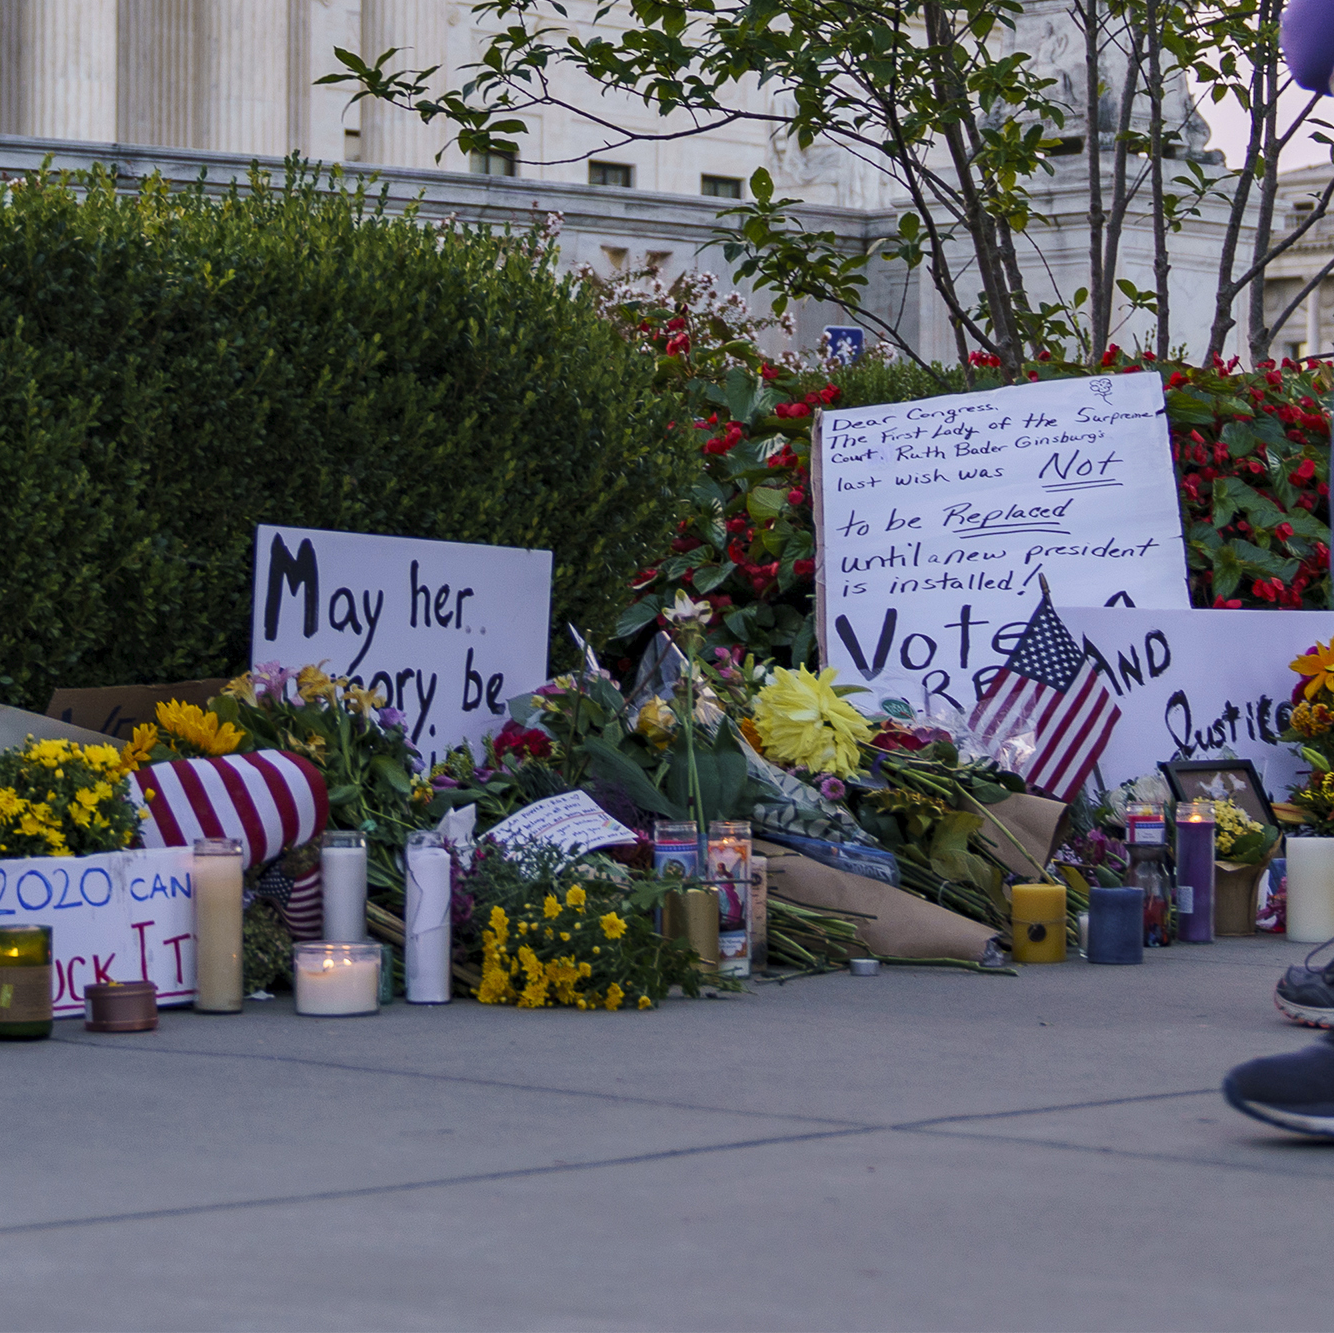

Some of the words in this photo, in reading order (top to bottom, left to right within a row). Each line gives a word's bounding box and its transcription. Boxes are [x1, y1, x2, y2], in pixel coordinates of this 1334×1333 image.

[825, 433, 868, 450] The
[880, 426, 928, 444] First
[931, 421, 980, 441] Lady
[988, 416, 1013, 430] of
[1022, 412, 1059, 429] the
[831, 415, 898, 432] Dear
[895, 444, 947, 462] Ruth
[953, 440, 1009, 458] Bader
[1014, 429, 1106, 449] Ginsburg's
[837, 475, 882, 493] last
[895, 468, 951, 487] wish
[958, 467, 1005, 481] was
[836, 510, 870, 538] to
[885, 508, 923, 532] be
[942, 498, 1075, 529] Replaced
[841, 542, 922, 574] until
[928, 552, 942, 565] a
[944, 548, 1007, 566] new
[1024, 537, 1161, 565] president
[842, 580, 868, 597] is
[889, 563, 1044, 596] installed!
[264, 532, 384, 676] May
[410, 559, 474, 630] her
[834, 604, 1029, 682] Vote
[462, 646, 506, 715] be
[130, 872, 192, 902] CAN
